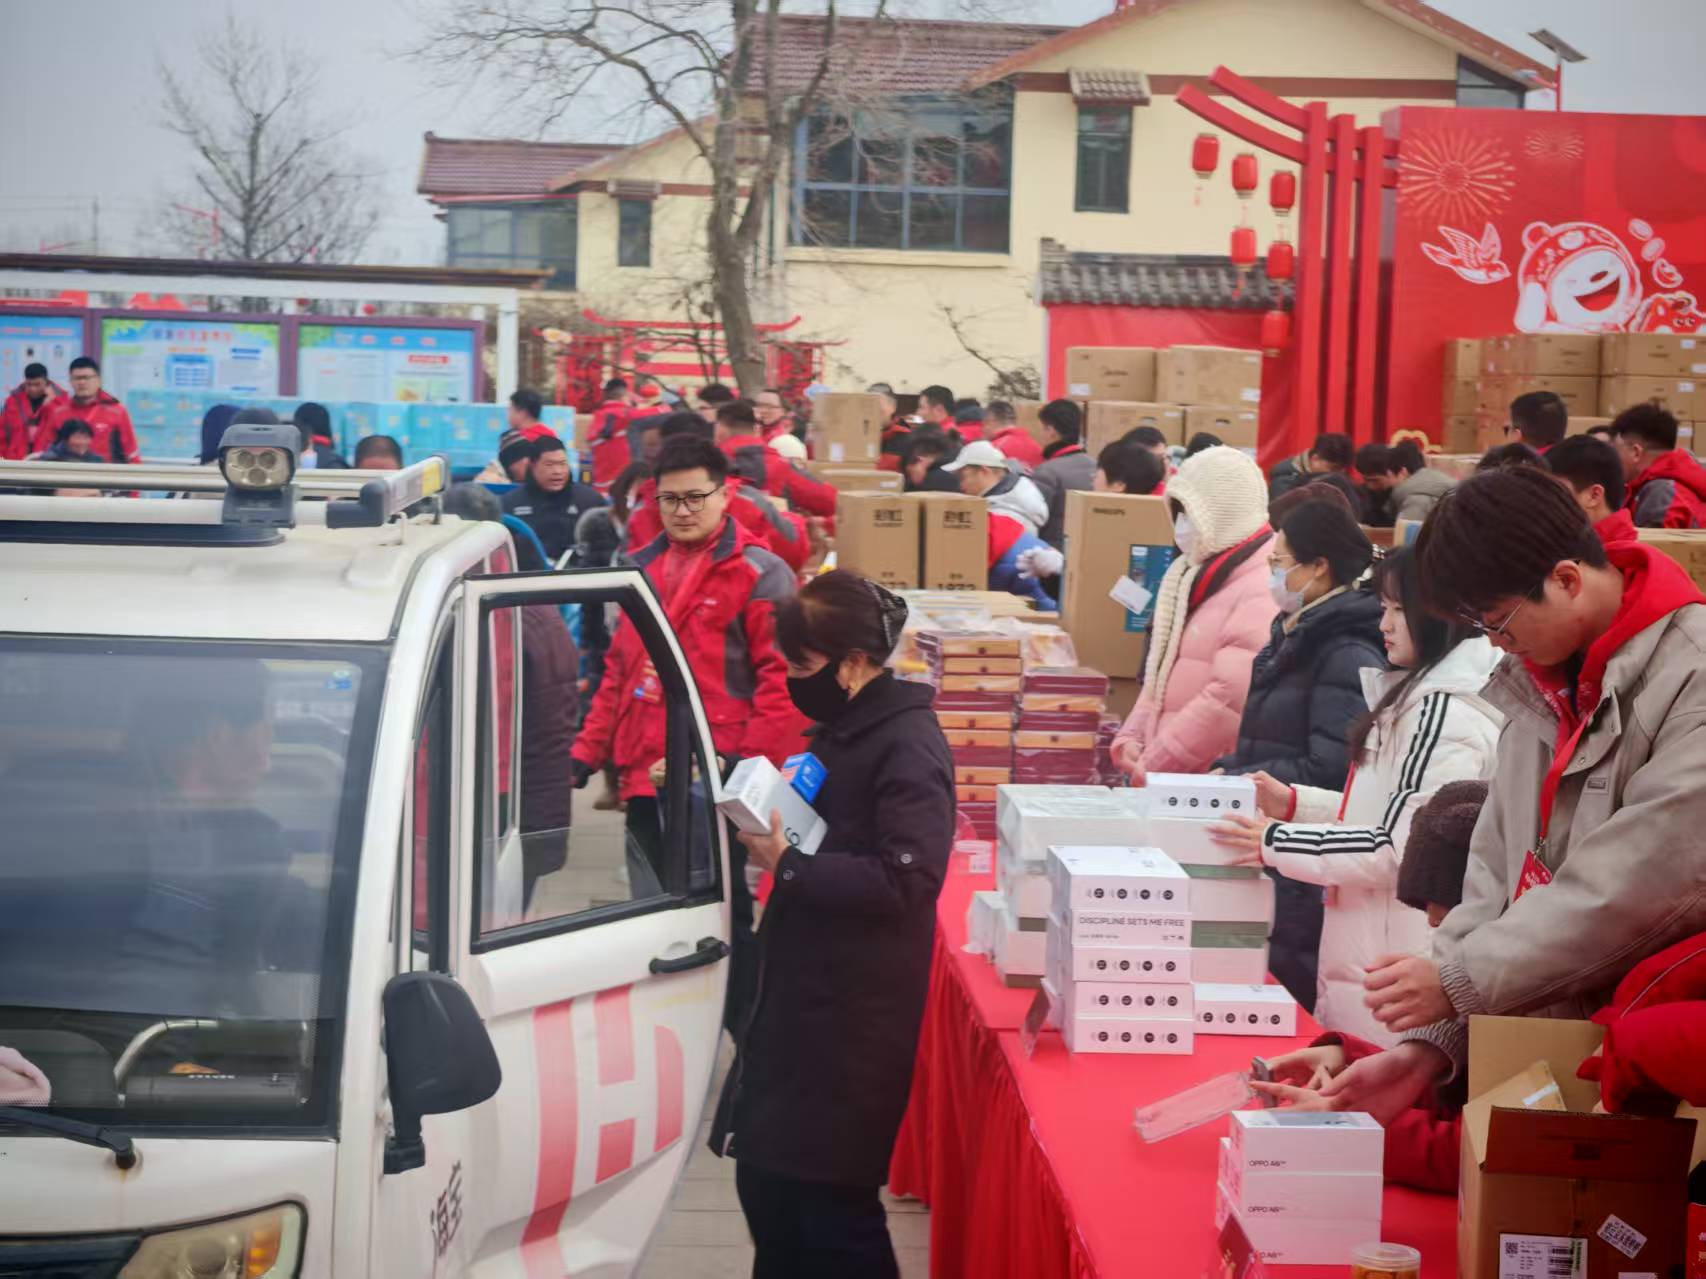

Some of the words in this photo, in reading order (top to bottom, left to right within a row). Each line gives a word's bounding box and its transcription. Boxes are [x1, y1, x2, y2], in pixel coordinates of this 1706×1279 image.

[1079, 916, 1125, 926] DISCIPLINE
[1127, 918, 1148, 926] SETS
[1149, 919, 1162, 927] ME
[1164, 919, 1185, 927] FREE
[1249, 1159, 1269, 1167] OPPO
[1247, 1205, 1267, 1213] OPPO
